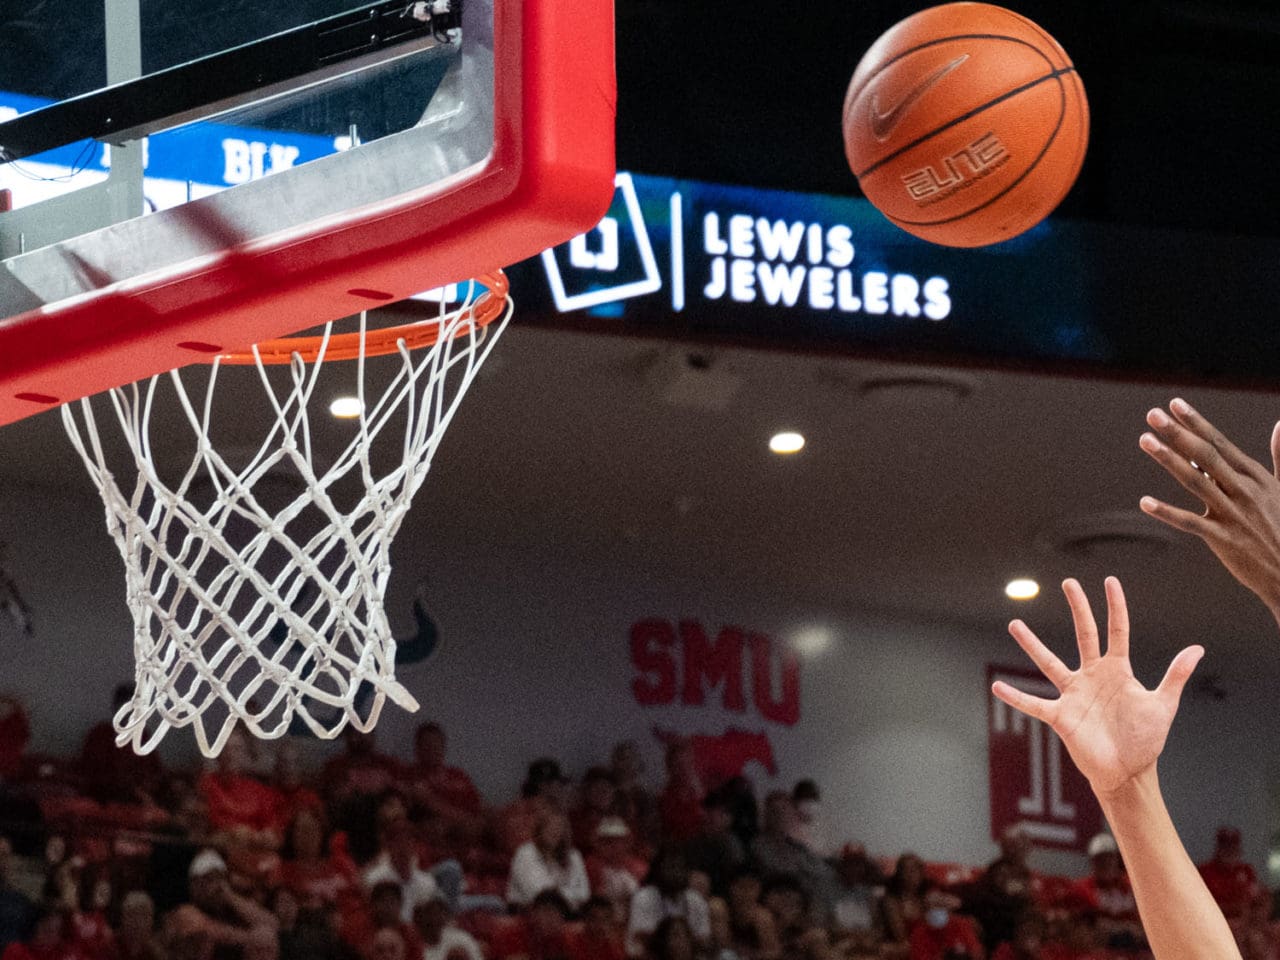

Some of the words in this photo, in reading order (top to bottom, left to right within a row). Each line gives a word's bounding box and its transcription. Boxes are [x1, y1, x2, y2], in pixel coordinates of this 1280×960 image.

[902, 130, 1006, 201] ELITE
[703, 211, 855, 268] LEWIS
[703, 256, 951, 320] JEWELERS
[630, 617, 800, 726] SMU
